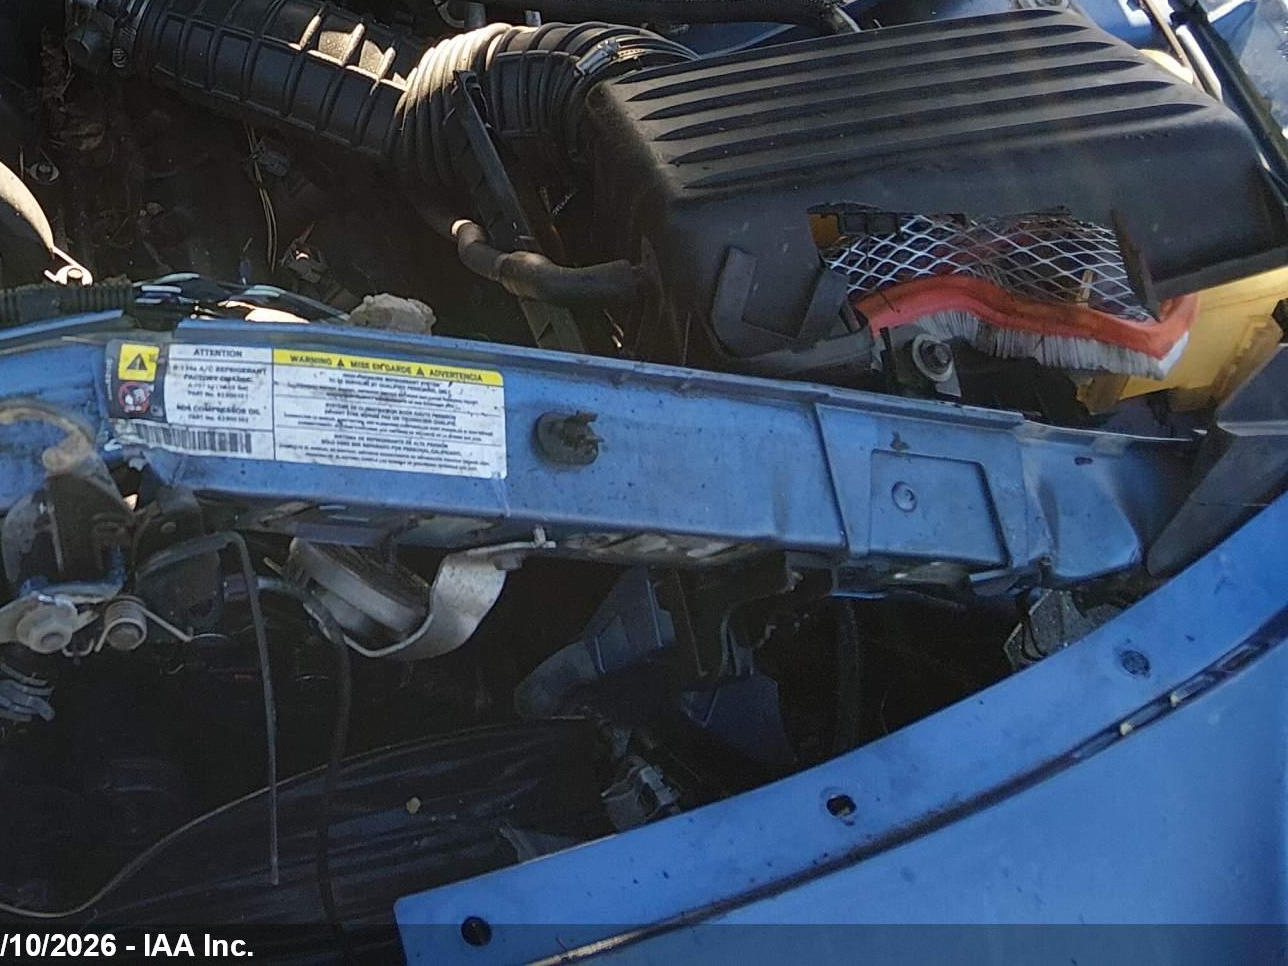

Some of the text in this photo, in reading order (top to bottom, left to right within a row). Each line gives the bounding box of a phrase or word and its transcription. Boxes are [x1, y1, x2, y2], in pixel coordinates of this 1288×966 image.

[192, 347, 242, 358] ATTENTION
[290, 355, 332, 366] WARNING
[429, 370, 483, 381] ADVERTENCIA
